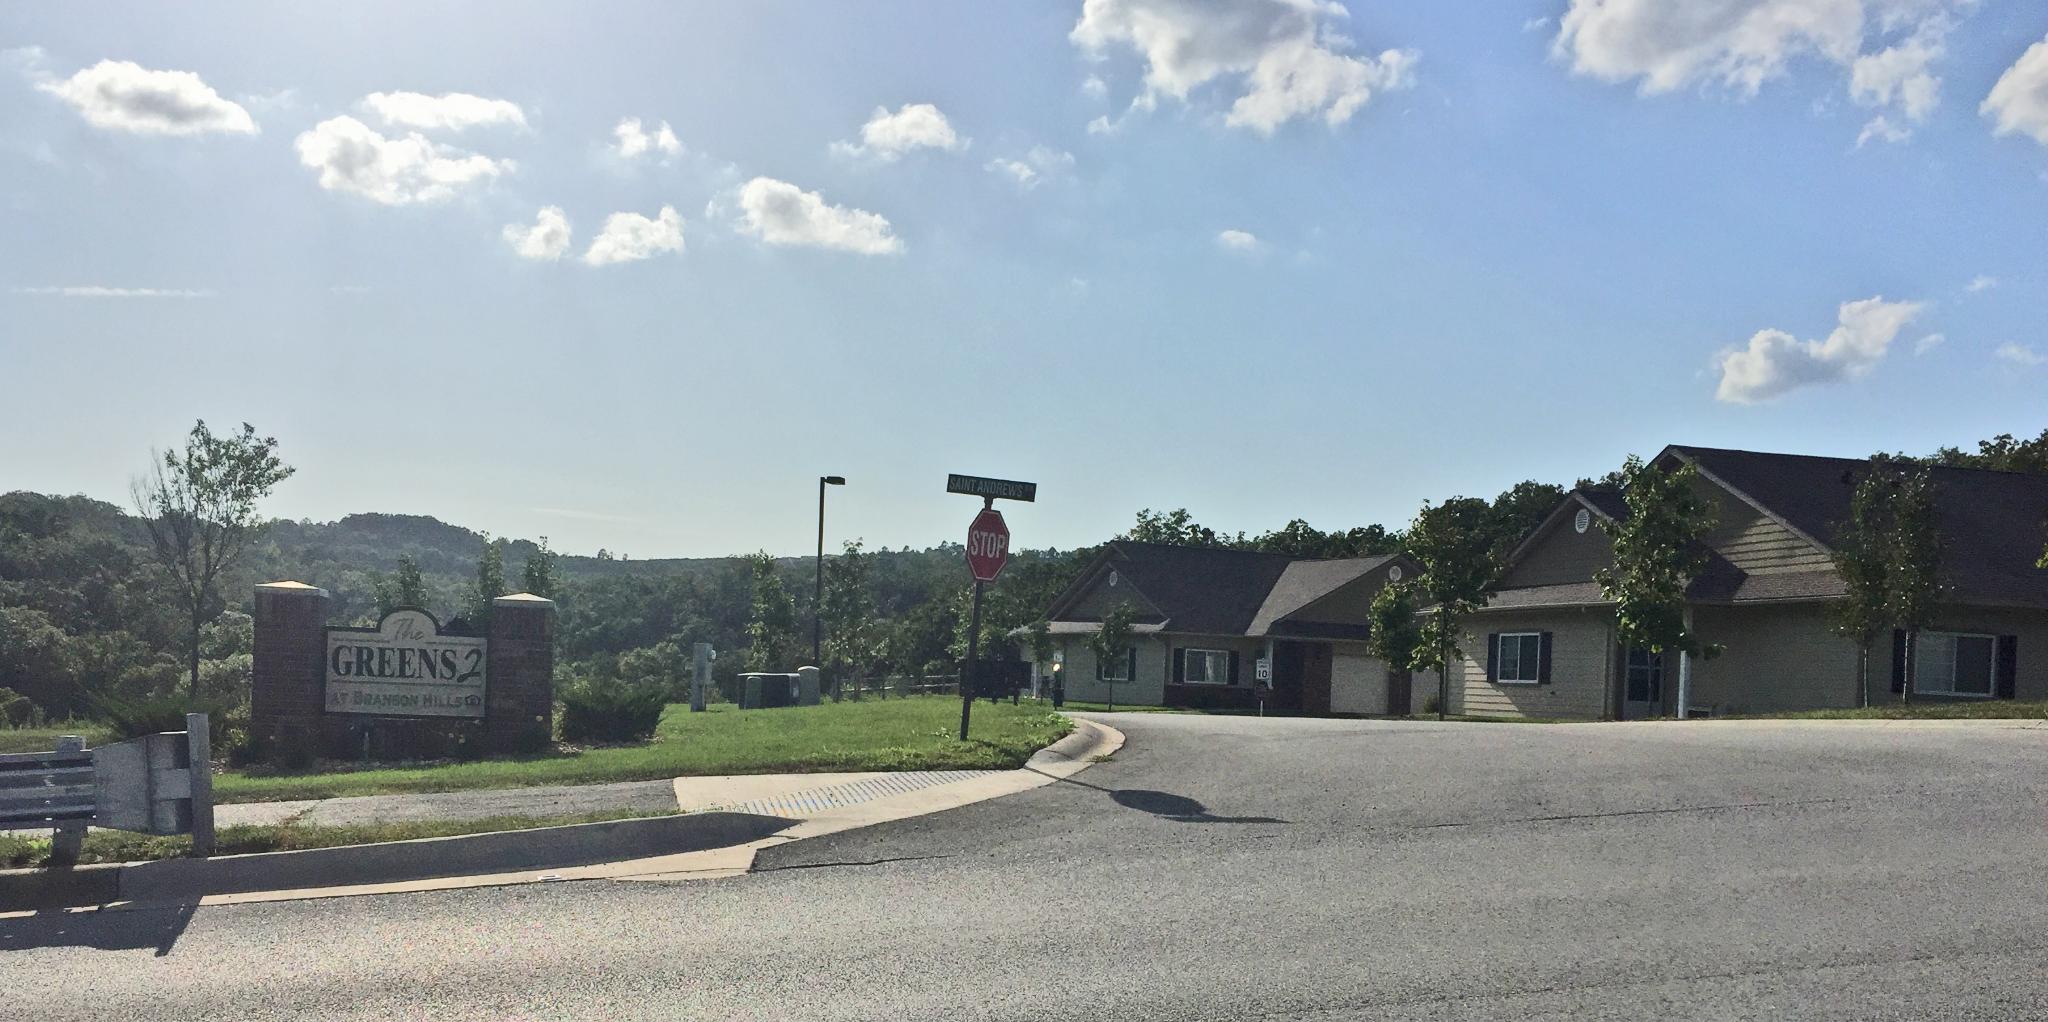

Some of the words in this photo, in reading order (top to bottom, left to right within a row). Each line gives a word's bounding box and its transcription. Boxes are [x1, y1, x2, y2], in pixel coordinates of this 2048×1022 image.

[950, 477, 977, 492] SAINT
[977, 480, 1023, 497] ANDREWS
[970, 530, 1006, 558] STOP
[393, 617, 424, 641] The
[331, 645, 457, 680] GREENS
[1258, 670, 1268, 678] 10
[353, 690, 419, 707] BRANSON
[422, 694, 463, 708] HILLS
